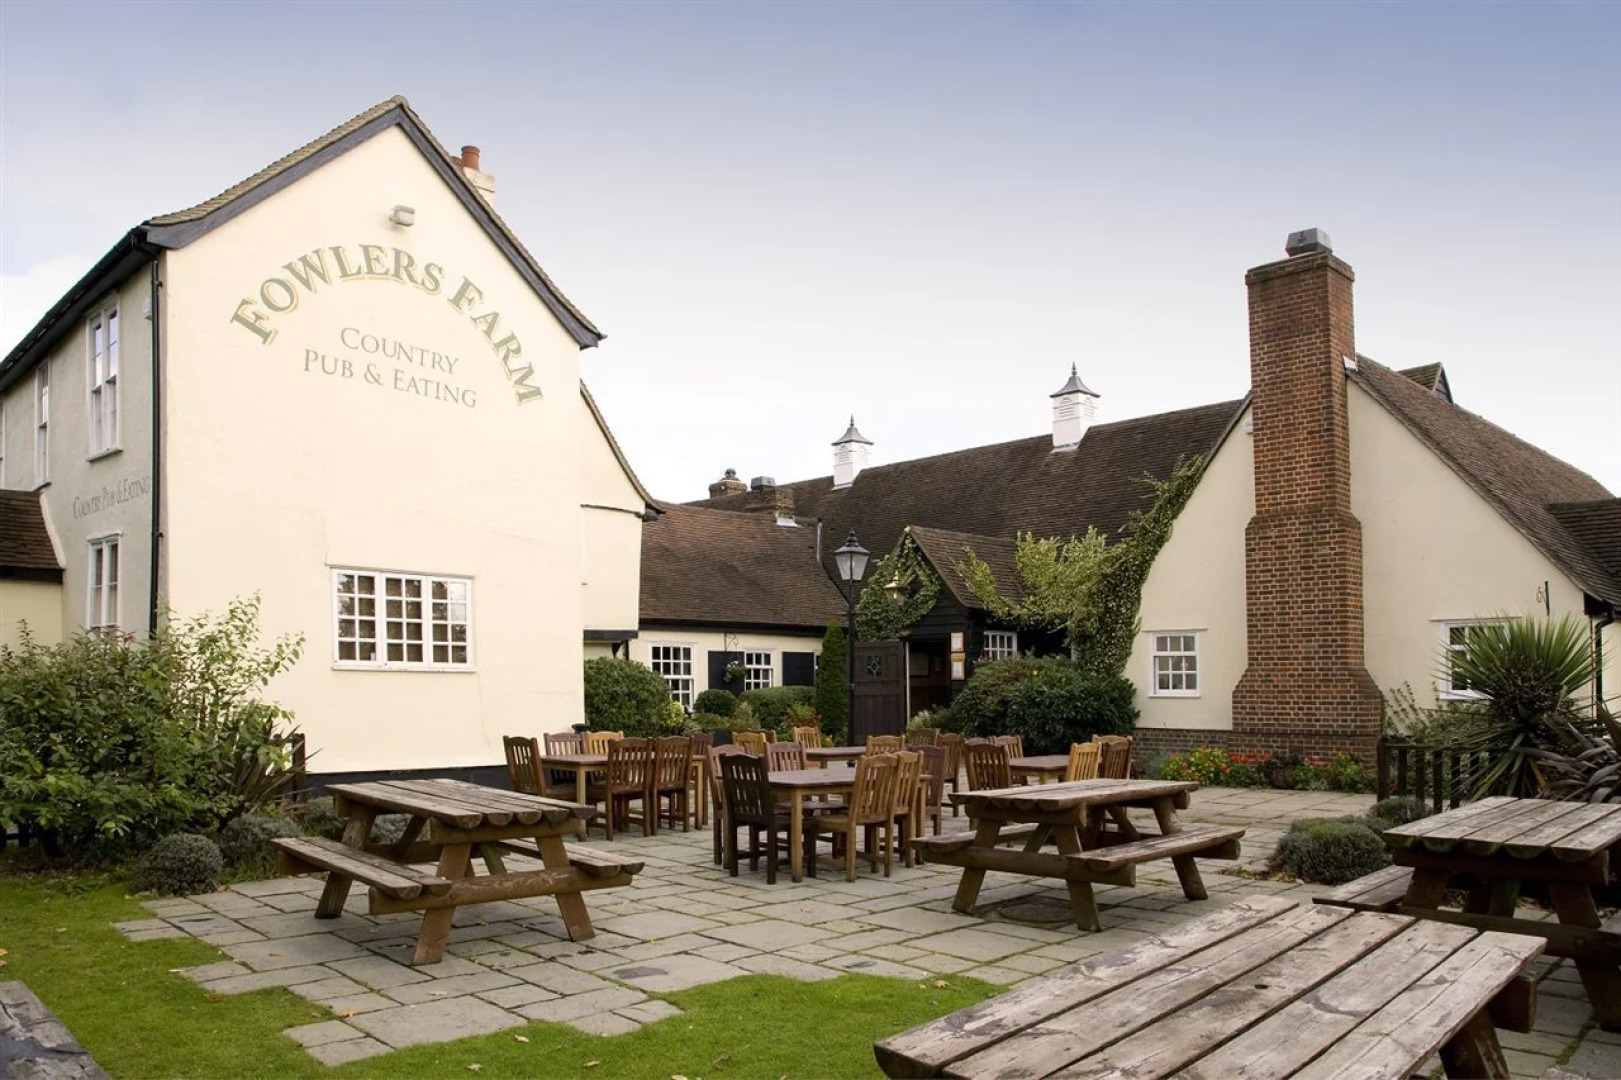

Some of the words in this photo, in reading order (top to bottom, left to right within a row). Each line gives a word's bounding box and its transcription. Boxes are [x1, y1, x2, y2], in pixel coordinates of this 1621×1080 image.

[230, 243, 444, 345] FOWLERS
[447, 276, 544, 406] FARM
[341, 327, 459, 374] COUNTRY
[303, 349, 354, 379] PUB
[364, 364, 382, 386] &
[393, 370, 477, 408] EATING
